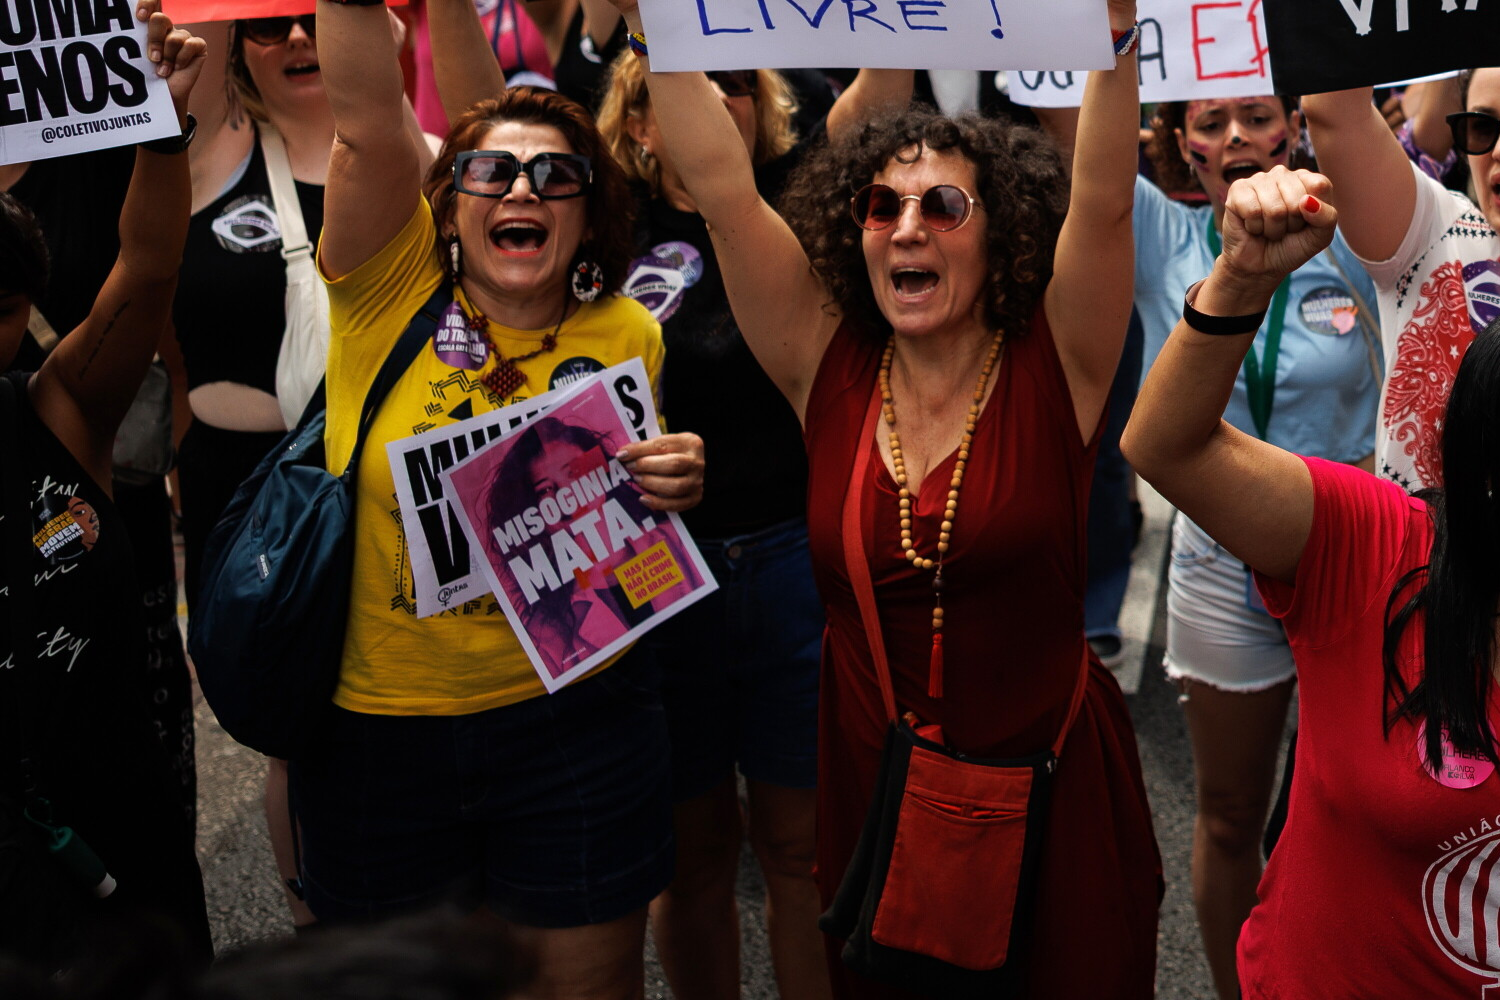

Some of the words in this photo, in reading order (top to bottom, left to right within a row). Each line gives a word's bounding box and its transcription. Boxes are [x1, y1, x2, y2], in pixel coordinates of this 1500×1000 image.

[41, 111, 152, 144] @COLETIVOJUNTAS
[492, 458, 632, 555] MISOGINIA
[35, 516, 76, 549] NEGRAS
[39, 521, 81, 554] MOVEM
[507, 497, 657, 606] MATA.
